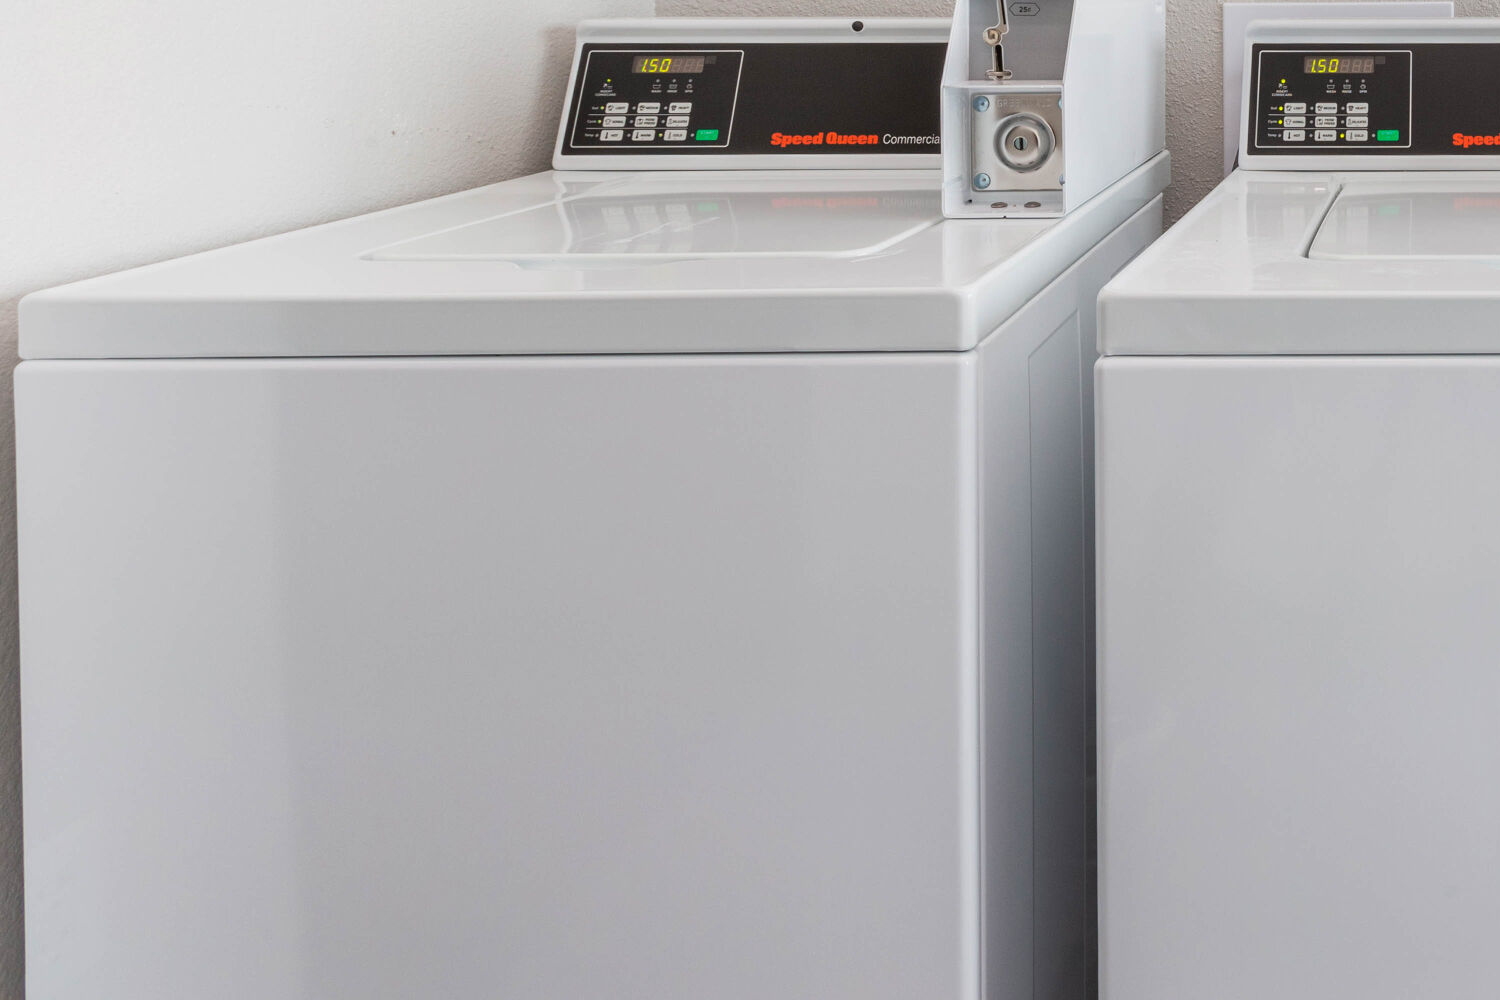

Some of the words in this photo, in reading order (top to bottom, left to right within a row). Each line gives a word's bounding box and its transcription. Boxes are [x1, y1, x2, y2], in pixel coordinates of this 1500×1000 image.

[1311, 59, 1339, 73] 1.50
[771, 132, 823, 148] Speed
[826, 132, 878, 145] Queen
[883, 133, 940, 145] Commercia
